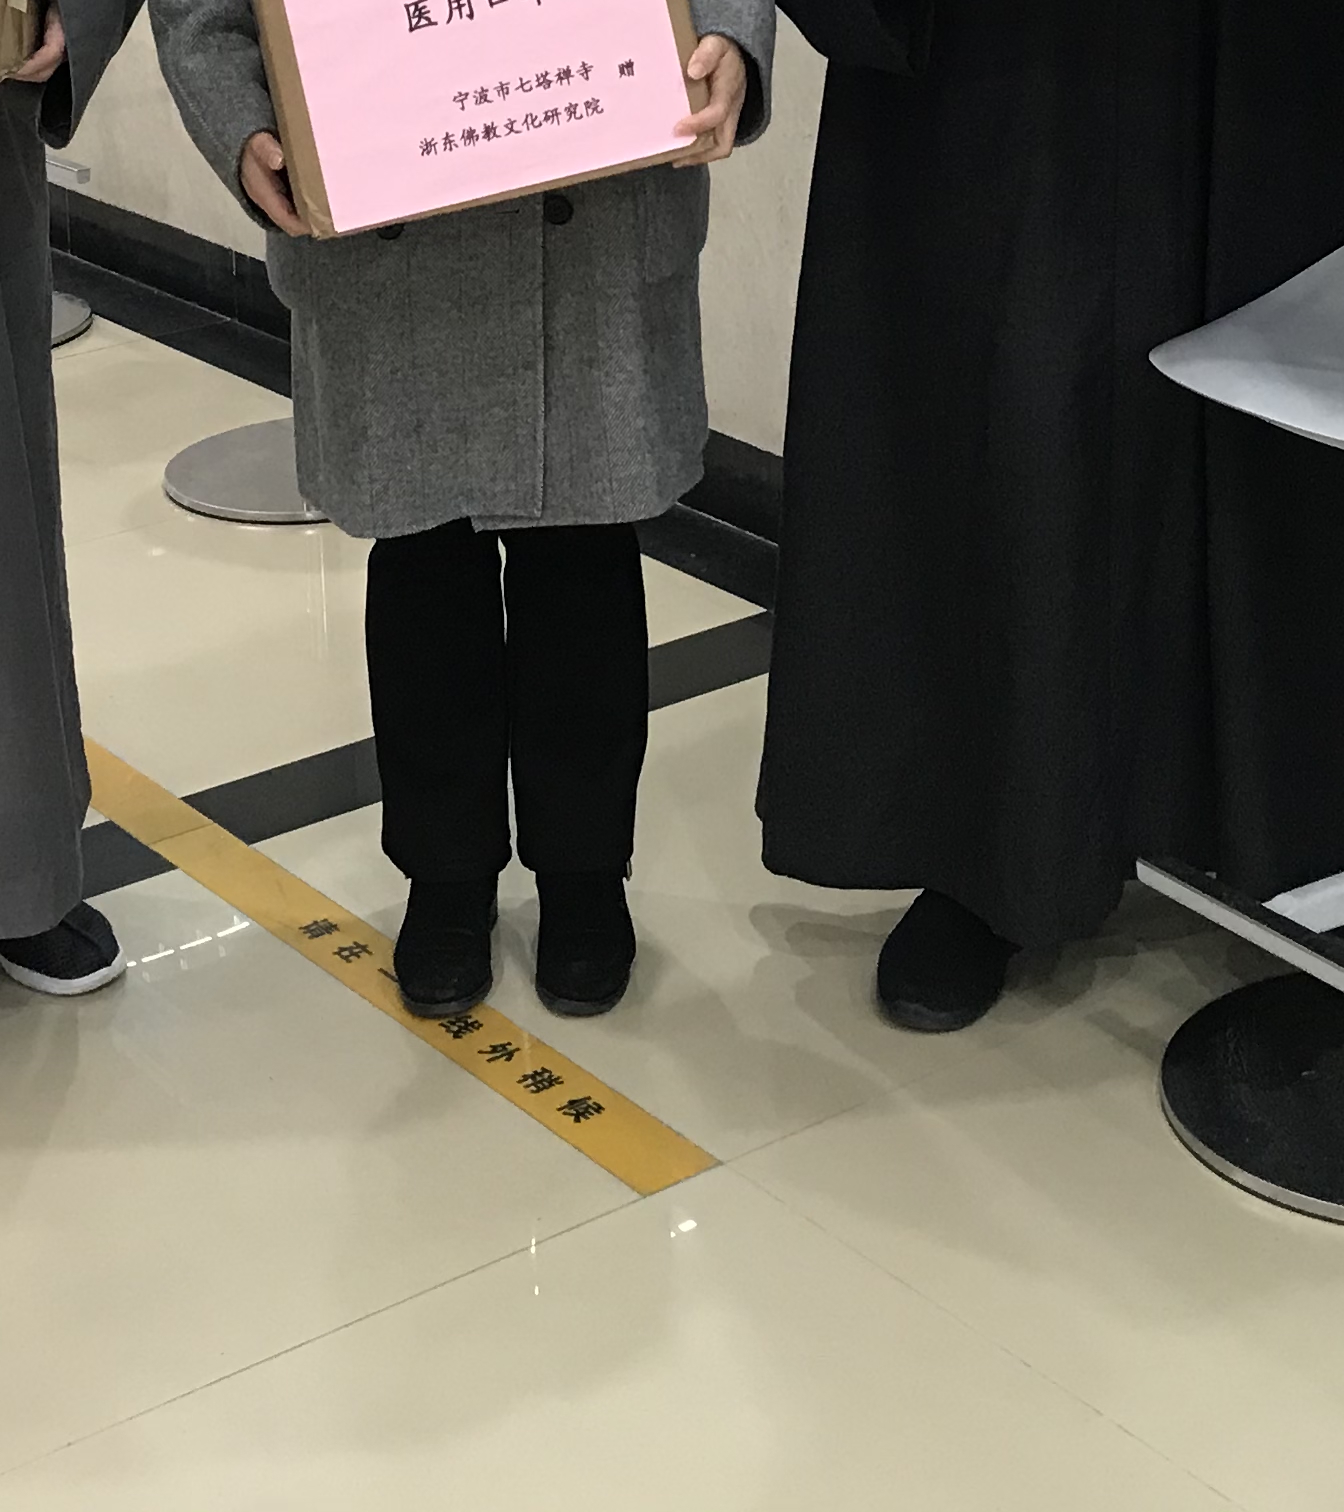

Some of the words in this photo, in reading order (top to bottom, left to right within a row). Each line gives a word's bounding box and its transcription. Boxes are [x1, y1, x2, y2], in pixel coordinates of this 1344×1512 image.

[452, 61, 594, 112] 宁波市七塔禅寺
[618, 59, 635, 78] 赠
[419, 97, 604, 157] 浙东佛教文化研究院
[297, 917, 607, 1124] 请在一线外稍候
